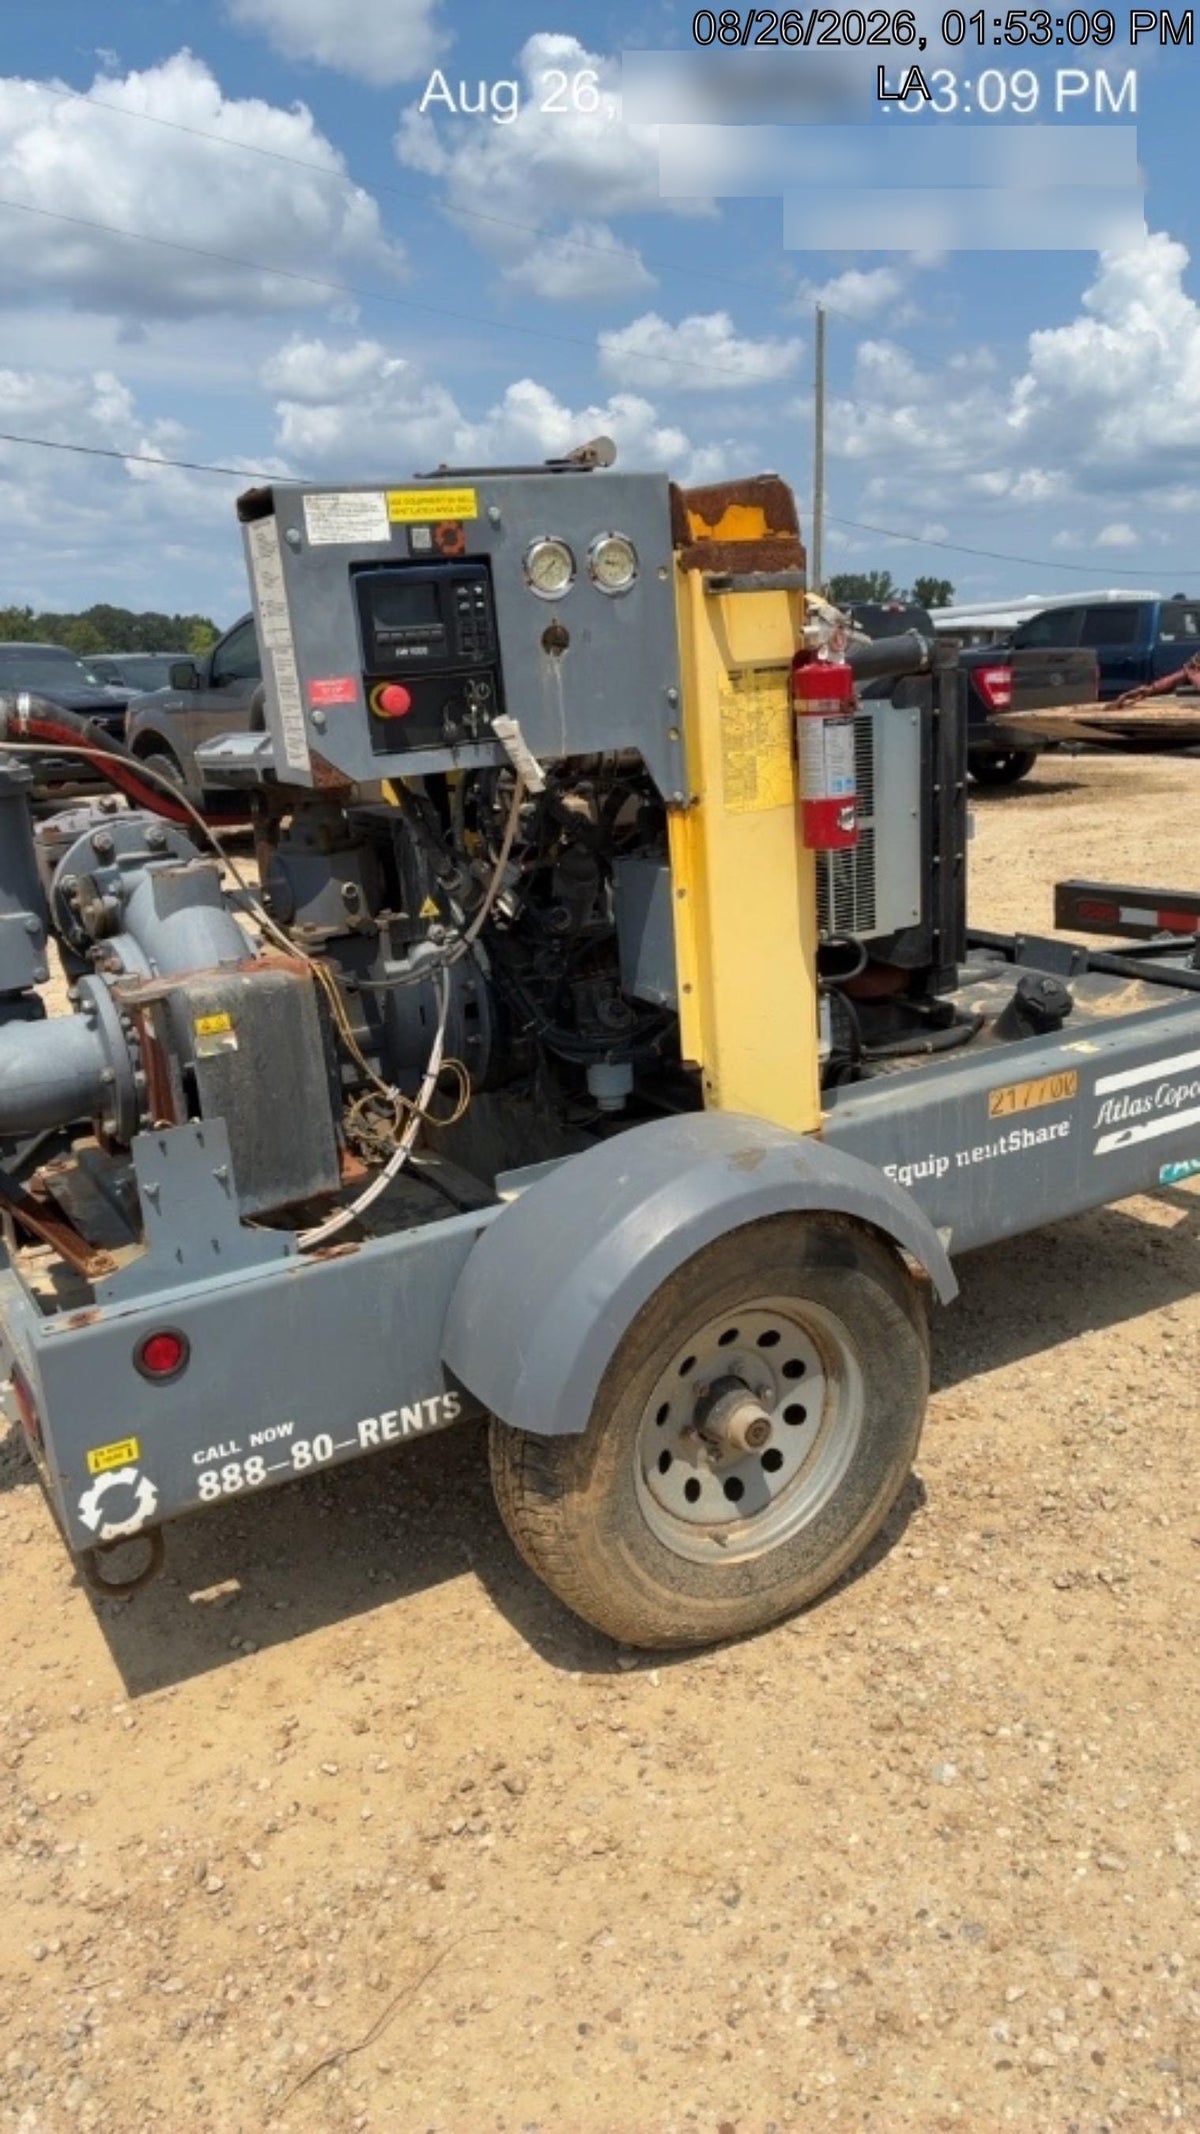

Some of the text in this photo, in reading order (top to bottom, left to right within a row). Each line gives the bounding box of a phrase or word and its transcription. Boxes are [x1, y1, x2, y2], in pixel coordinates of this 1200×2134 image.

[1092, 1080, 1200, 1130] Atlas Copc
[192, 1422, 294, 1465] CALL NOW
